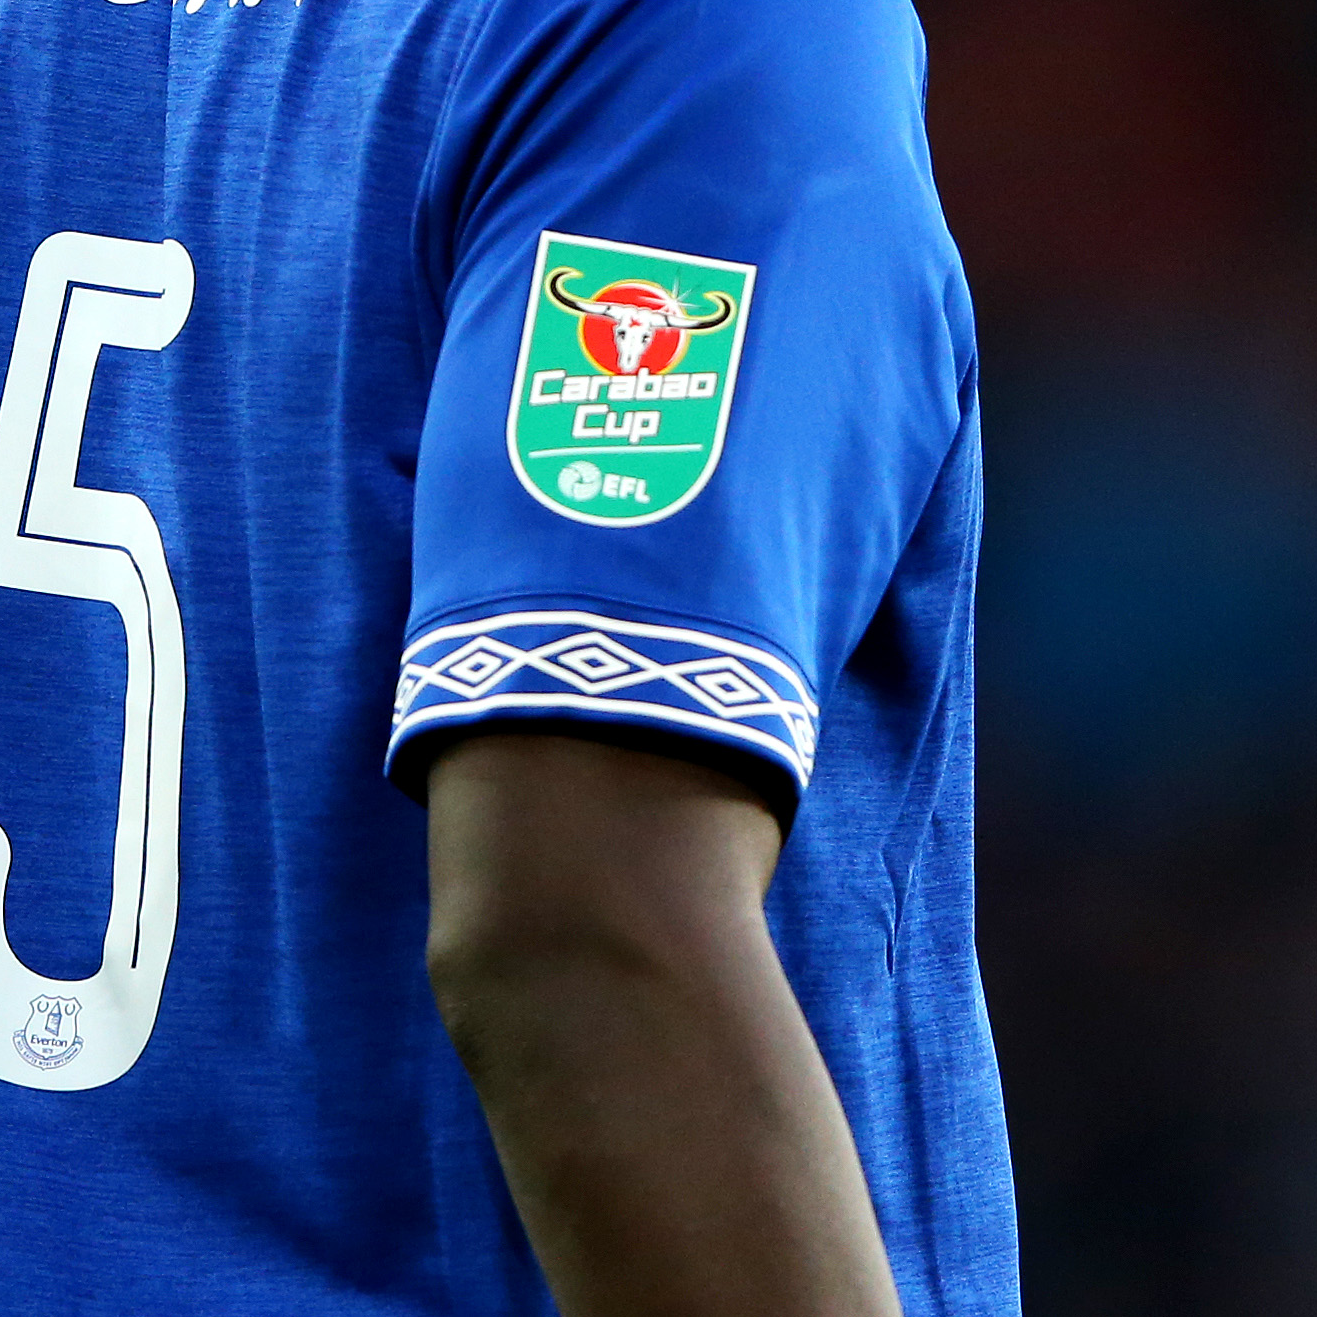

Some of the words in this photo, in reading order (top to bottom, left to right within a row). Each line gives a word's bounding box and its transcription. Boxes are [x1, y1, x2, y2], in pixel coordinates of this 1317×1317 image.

[529, 368, 718, 406] Carabao
[572, 404, 661, 445] Cup
[602, 473, 651, 504] EFL
[30, 1034, 68, 1048] Everton
